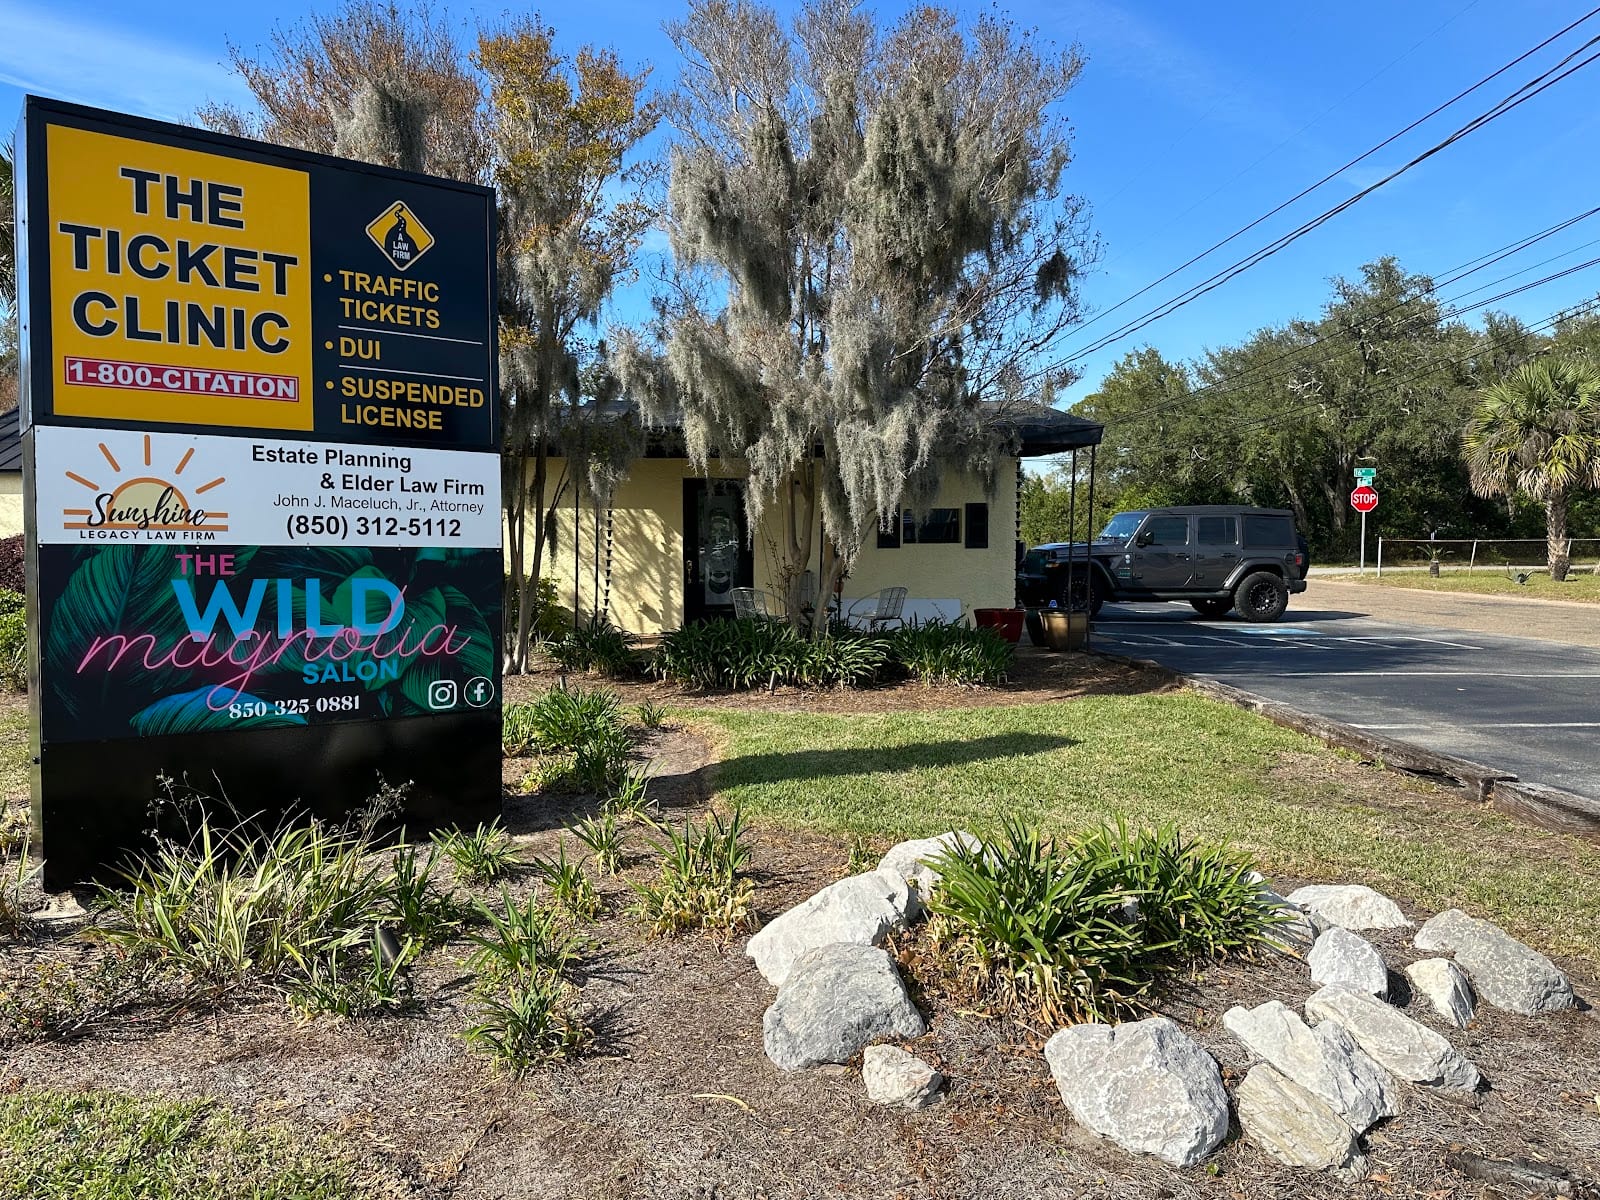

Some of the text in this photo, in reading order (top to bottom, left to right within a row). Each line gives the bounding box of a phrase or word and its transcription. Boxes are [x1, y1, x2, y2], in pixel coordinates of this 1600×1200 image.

[120, 167, 244, 230] THE
[393, 241, 408, 251] LAW
[398, 233, 404, 241] A
[58, 222, 298, 296] TICKET
[393, 250, 410, 260] FIRM
[339, 270, 440, 302] TRAFFIC
[72, 291, 290, 354] CLINIC
[339, 298, 440, 329] TICKETS
[340, 337, 381, 360] DUI
[69, 362, 295, 398] 1-800-CITATION
[341, 377, 483, 408] SUSPENDED
[342, 404, 442, 430] LICENSE
[252, 445, 411, 472] Estate Planning
[320, 473, 484, 496] & Elder Law Firm
[87, 487, 207, 529] Sunshine
[274, 494, 484, 514] John J. Maceluch, Jr., Attorney
[1353, 494, 1376, 504] STOP
[80, 530, 215, 540] LEGACY LAW FIRM
[287, 515, 460, 539] (850) 312-5112
[175, 554, 235, 576] THE
[172, 578, 405, 642] WILD
[77, 585, 471, 711] magnolia
[303, 660, 398, 685] SALON
